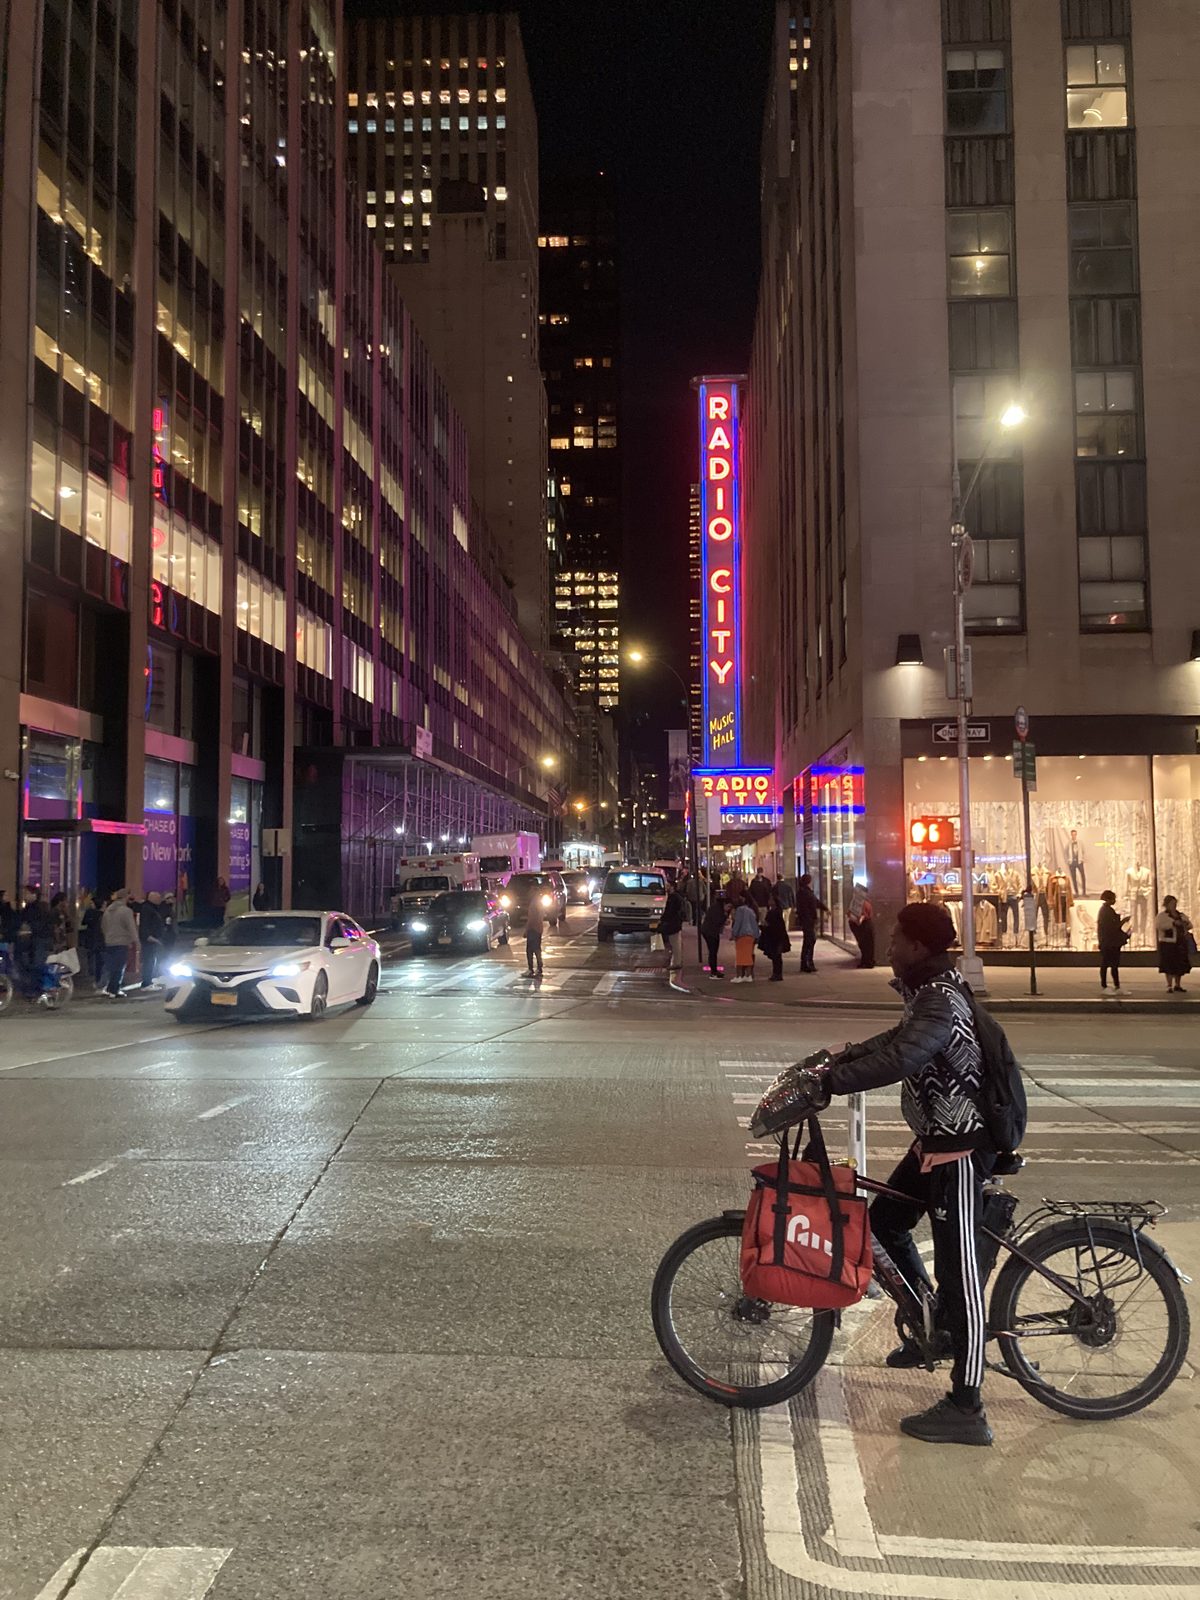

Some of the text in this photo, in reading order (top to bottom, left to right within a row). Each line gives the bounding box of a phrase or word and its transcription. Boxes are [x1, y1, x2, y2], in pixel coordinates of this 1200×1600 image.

[708, 396, 733, 684] RADIO CITY
[740, 813, 772, 824] HALL
[150, 841, 172, 862] New
